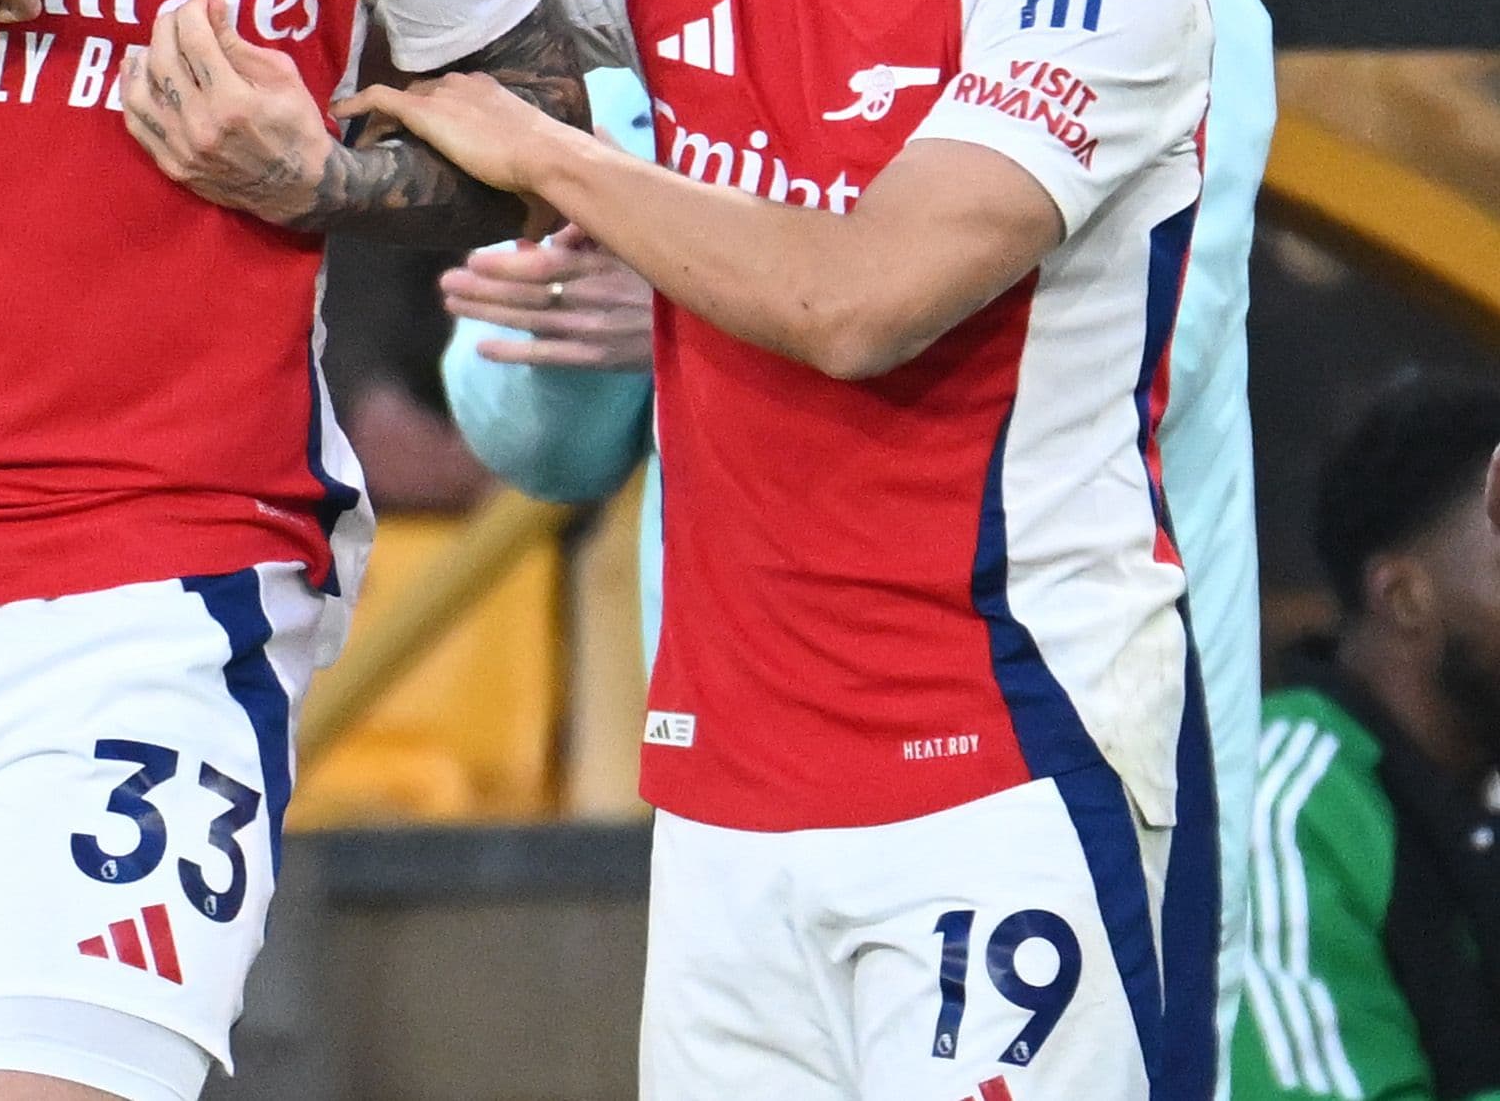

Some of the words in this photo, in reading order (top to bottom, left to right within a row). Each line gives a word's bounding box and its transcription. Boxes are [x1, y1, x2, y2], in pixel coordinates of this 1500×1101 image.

[953, 72, 1100, 173] RWANDA
[1009, 60, 1099, 117] VISIT
[903, 733, 980, 761] HEAT.RDY
[70, 738, 263, 924] 33
[931, 908, 1083, 1068] 19
